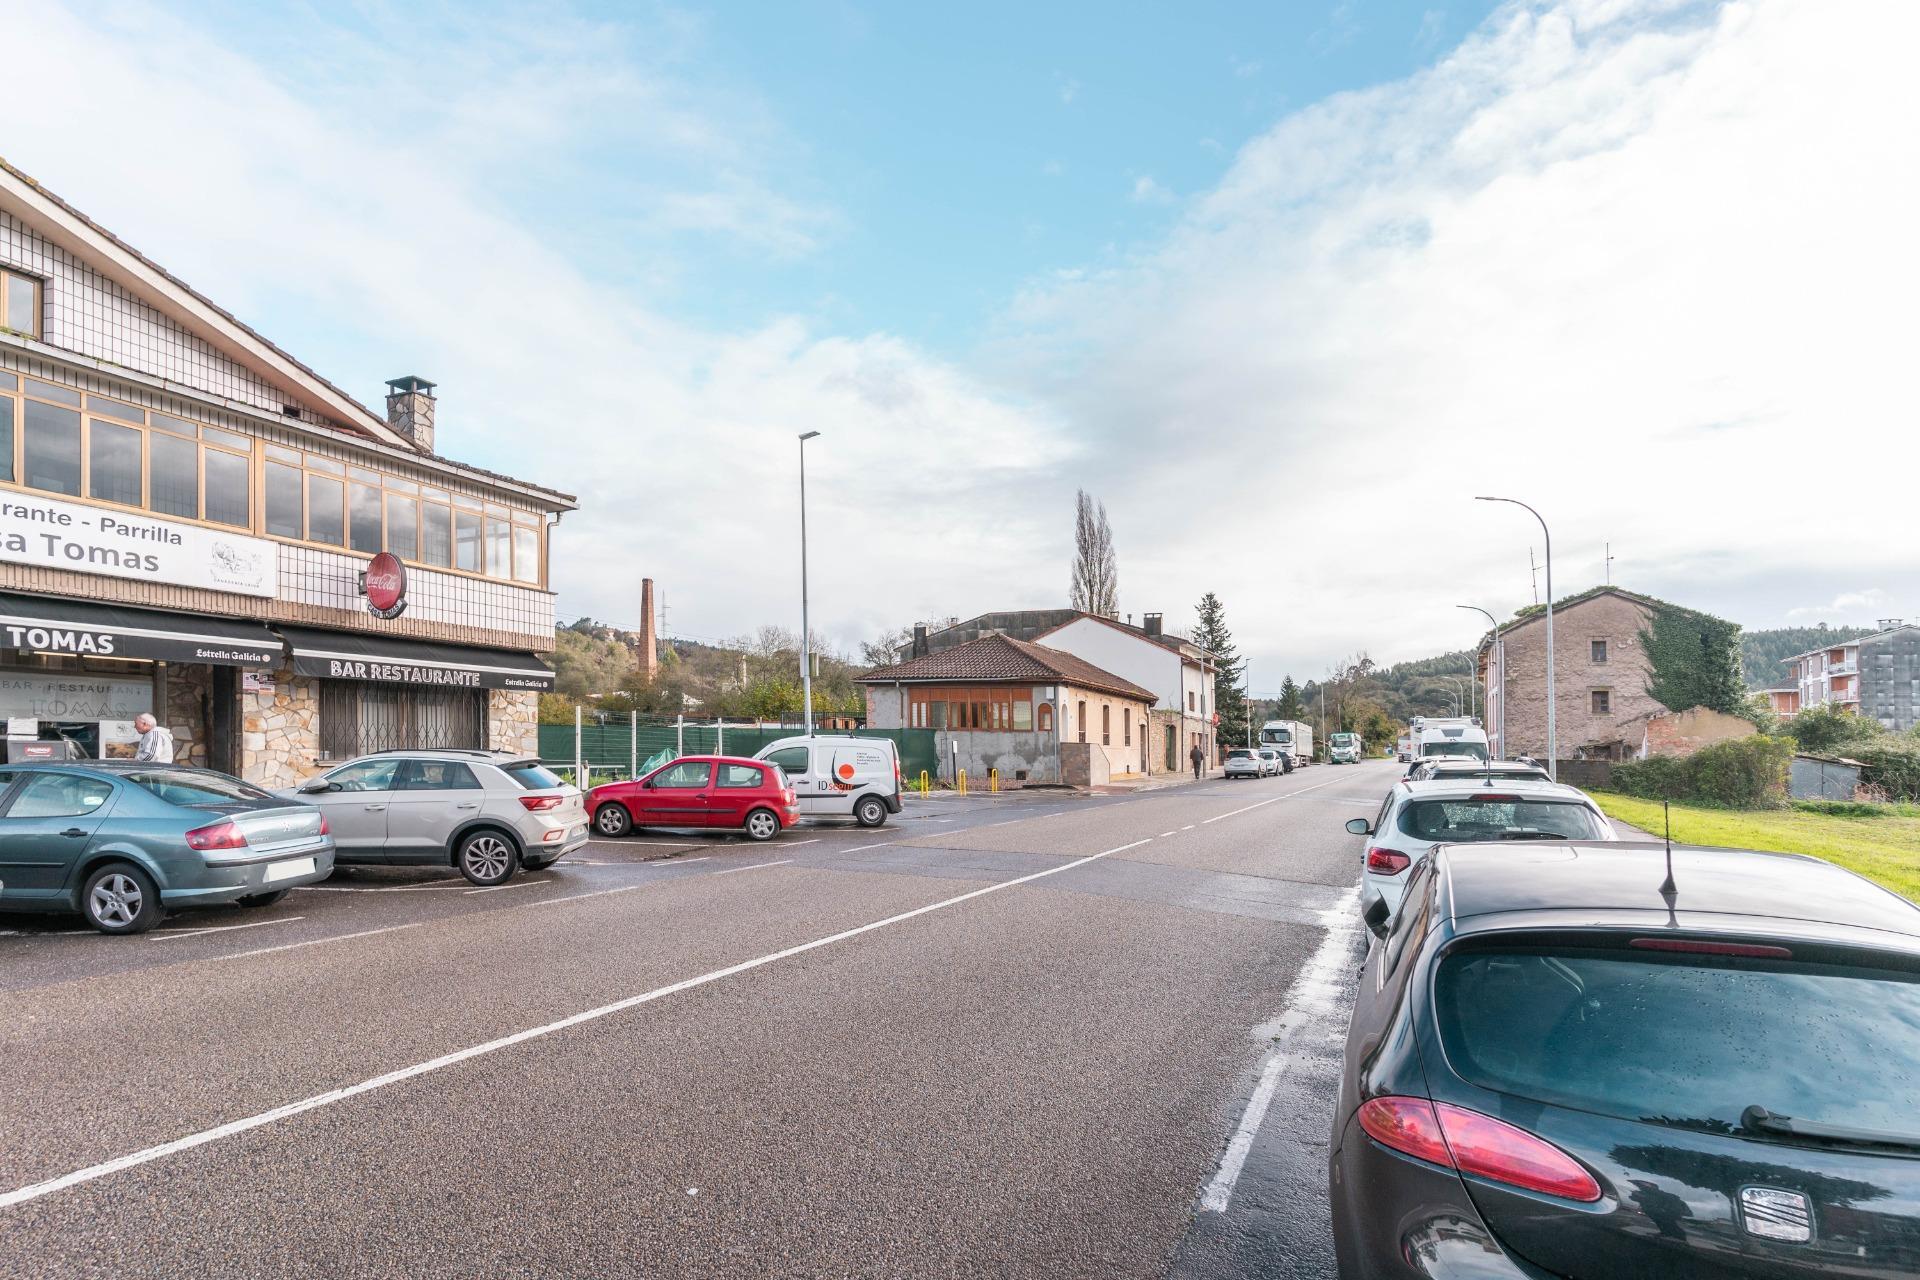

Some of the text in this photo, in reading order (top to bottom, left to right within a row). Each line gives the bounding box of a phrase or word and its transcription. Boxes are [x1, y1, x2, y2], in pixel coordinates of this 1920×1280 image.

[100, 517, 183, 545] Parrilla
[40, 533, 160, 572] Tomas
[6, 626, 115, 654] TOMAS
[195, 648, 261, 662] Estrella Galicia
[330, 660, 480, 687] BAR RESTAURANTE
[504, 678, 542, 688] Estrella Galicia
[2, 680, 33, 691] BAR
[29, 699, 129, 719] TOMAS
